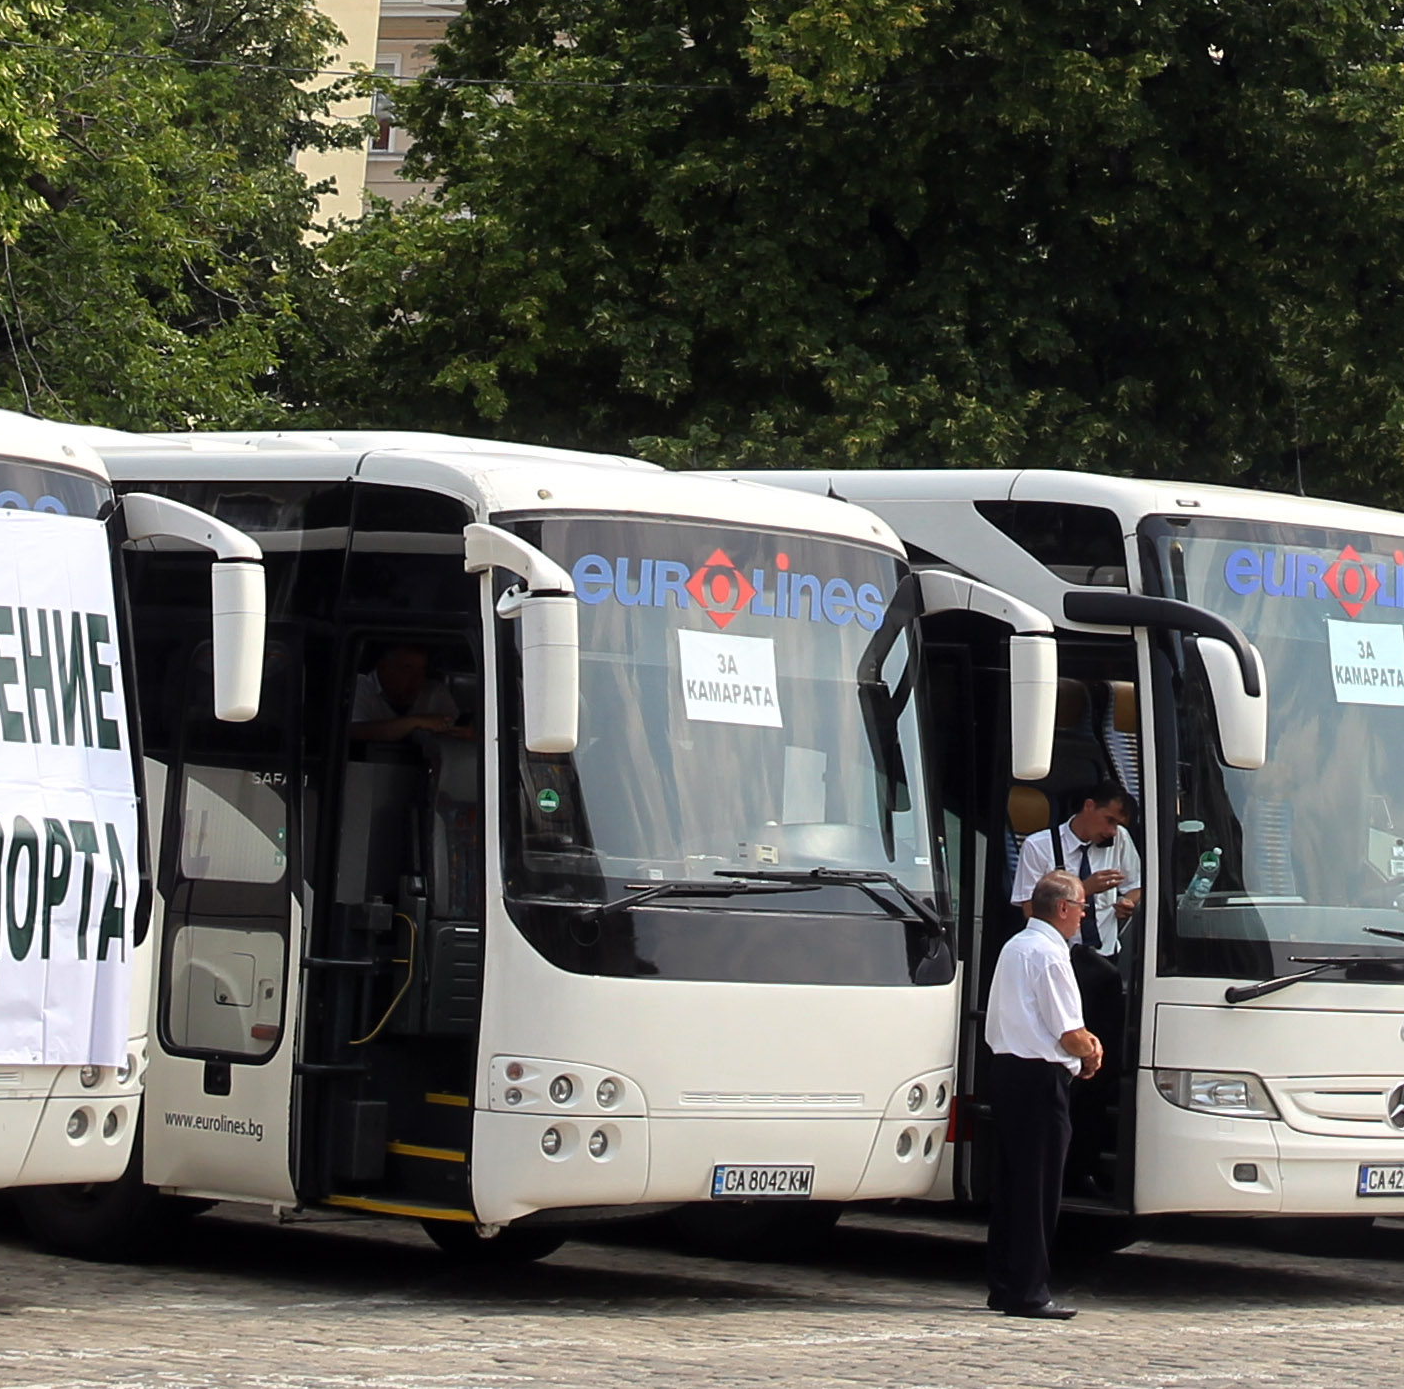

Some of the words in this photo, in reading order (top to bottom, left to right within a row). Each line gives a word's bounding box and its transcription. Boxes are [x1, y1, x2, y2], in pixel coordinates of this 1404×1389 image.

[1357, 640, 1375, 659] ЗА
[717, 653, 738, 676] ЗА
[1335, 665, 1404, 688] КАМАРАТА
[687, 678, 774, 707] КАМАРАТА
[164, 1112, 263, 1142] www.eurolines.bg
[725, 1170, 745, 1191] CA
[749, 1170, 787, 1191] 8042
[788, 1171, 810, 1191] KM
[1369, 1170, 1385, 1189] CA
